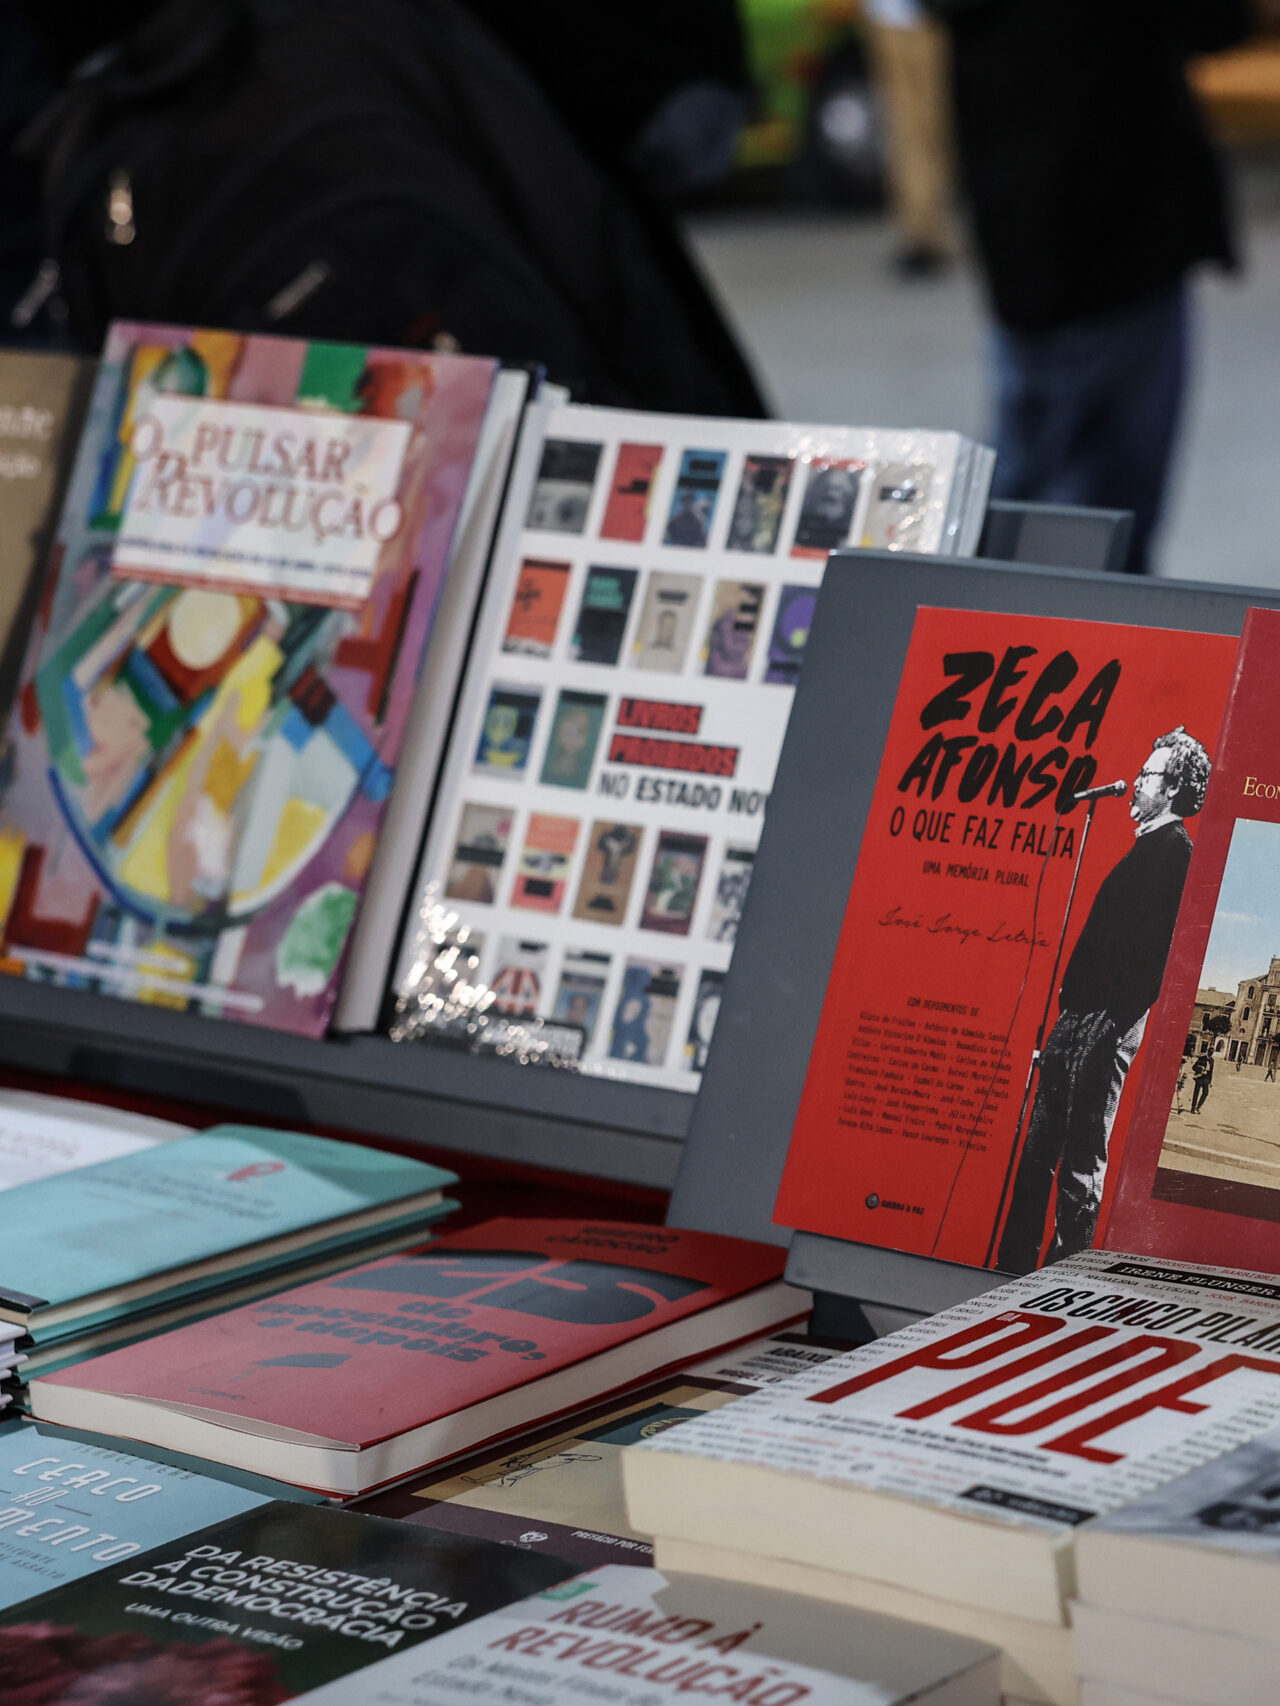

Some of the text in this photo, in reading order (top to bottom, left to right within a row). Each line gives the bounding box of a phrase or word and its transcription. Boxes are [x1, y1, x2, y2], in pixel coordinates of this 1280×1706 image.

[191, 420, 351, 484] PULSAR
[920, 645, 1122, 749] ZECA
[636, 776, 722, 810] ESTADO
[897, 732, 1098, 815] AFONSO
[889, 806, 1077, 860] O QUE FAZ FALTA
[923, 860, 1030, 888] UMA MEMÓRIA PLURAL
[1119, 1266, 1181, 1281] IRENE
[1182, 1276, 1276, 1297] FLUNSER
[396, 1301, 473, 1320] de
[1019, 1287, 1095, 1313] OS
[1066, 1295, 1202, 1331] CINCO
[295, 1320, 491, 1362] depois
[10, 1486, 70, 1507] AO
[12, 1457, 163, 1502] CERCO
[184, 1544, 469, 1619] DA RESISTÊNCIA
[190, 1564, 437, 1630] CONSTRUÇÃO
[171, 1611, 240, 1635] OUTRA
[547, 1600, 714, 1645] RUMO
[488, 1625, 813, 1706] REVOLUÇÃO
